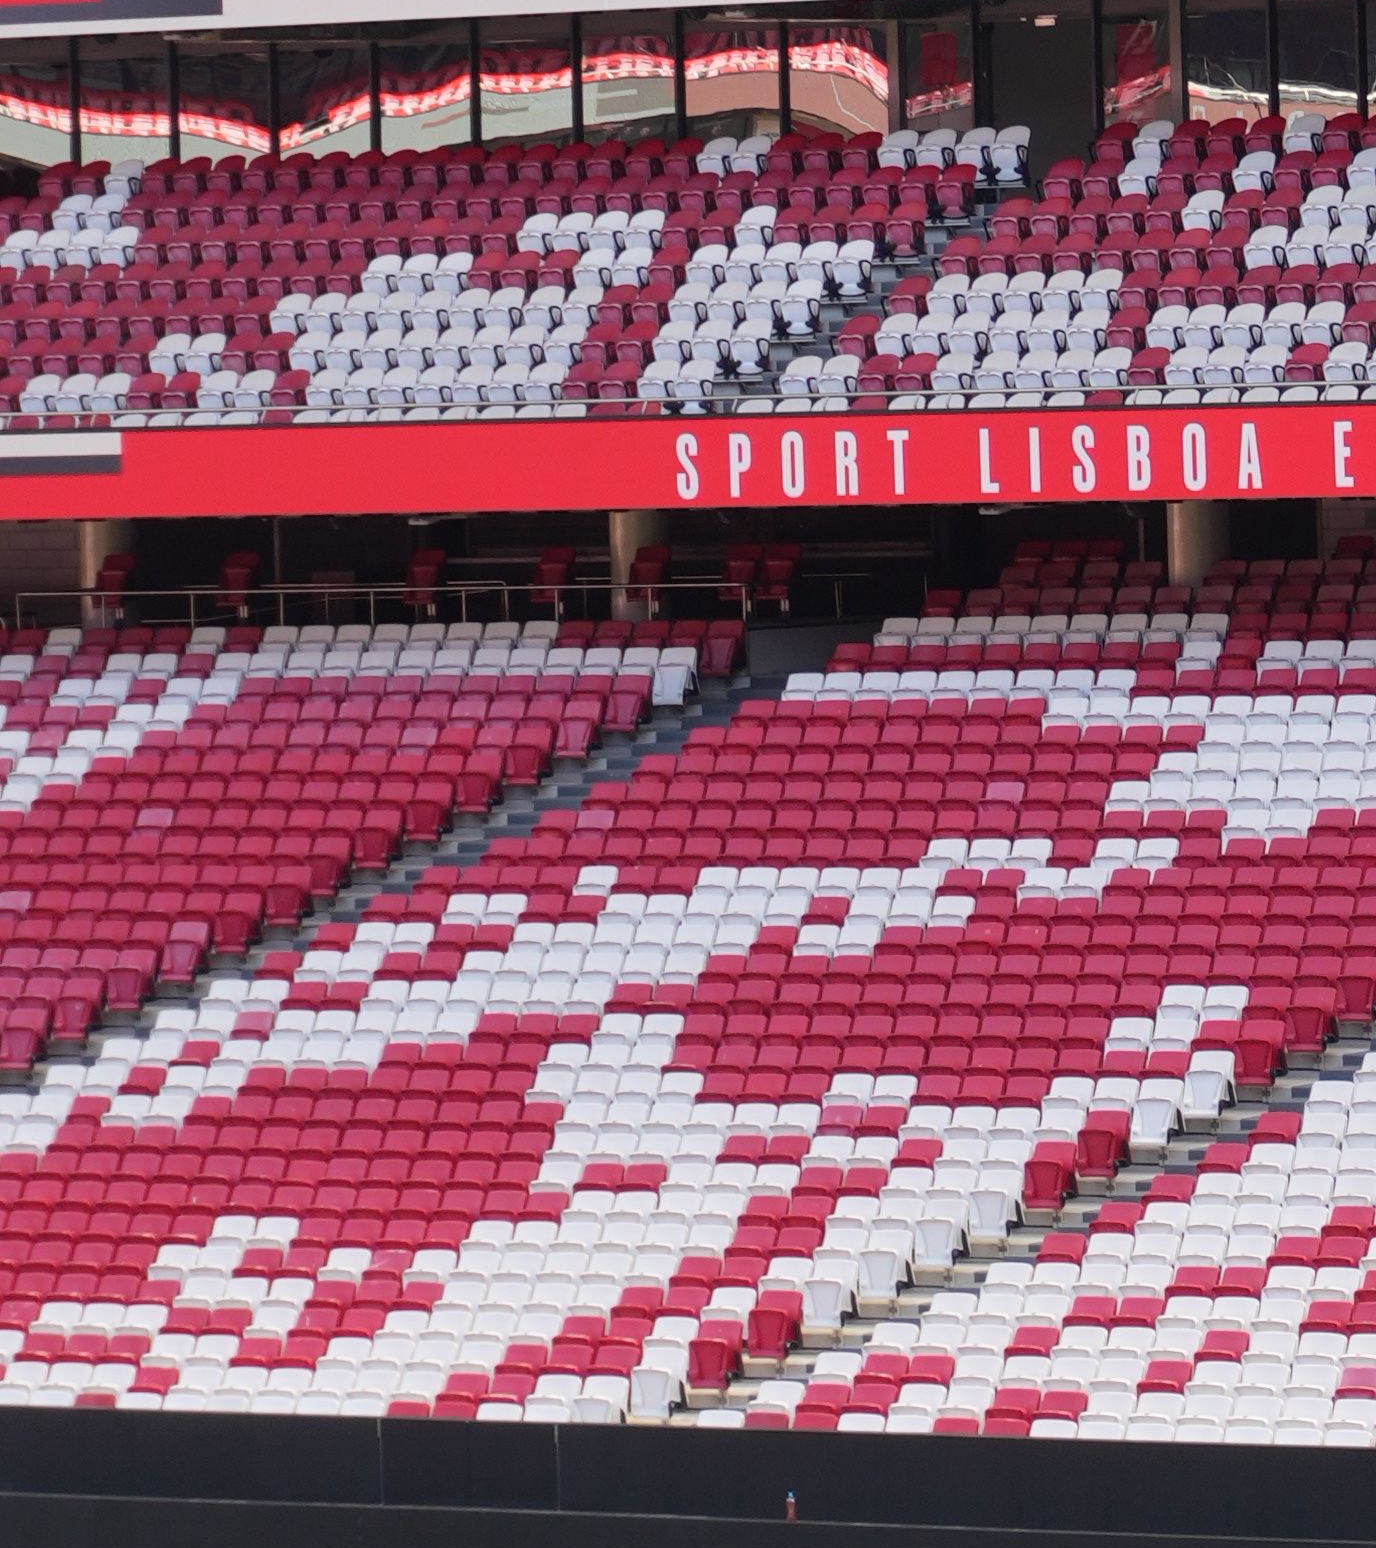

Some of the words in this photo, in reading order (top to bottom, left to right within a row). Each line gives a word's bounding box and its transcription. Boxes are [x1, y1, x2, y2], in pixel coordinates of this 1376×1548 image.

[675, 429, 910, 500] SPORT
[978, 422, 1263, 494] LISBOA
[1333, 420, 1355, 488] E
